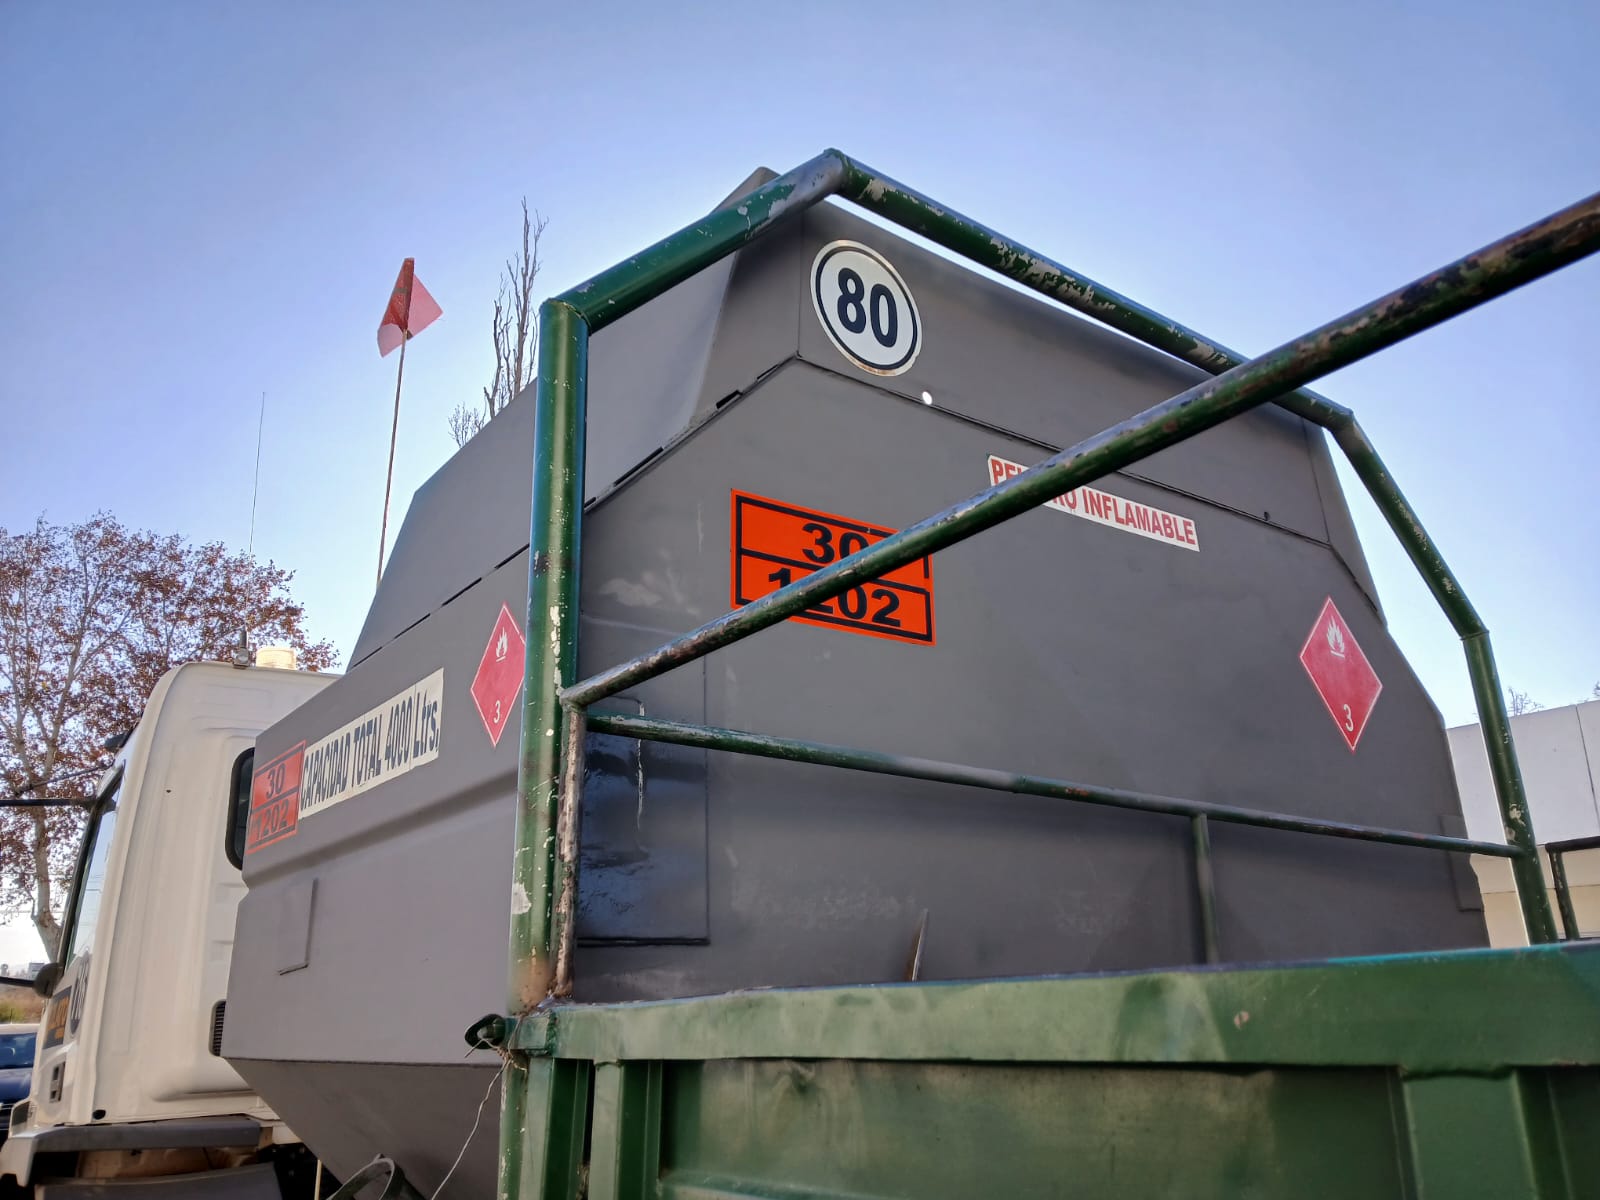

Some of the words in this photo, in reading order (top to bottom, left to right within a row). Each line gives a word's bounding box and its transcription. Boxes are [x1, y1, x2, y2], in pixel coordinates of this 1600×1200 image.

[837, 267, 898, 348] 80
[1082, 487, 1196, 545] INFLAMABLE
[769, 568, 900, 627] 102
[494, 700, 500, 723] 3
[1343, 704, 1354, 731] 3
[301, 731, 350, 811] CAPACIDAD
[352, 714, 383, 788] TOTAL
[384, 696, 412, 771] 4000
[266, 764, 286, 799] 30
[255, 799, 289, 840] 1202
